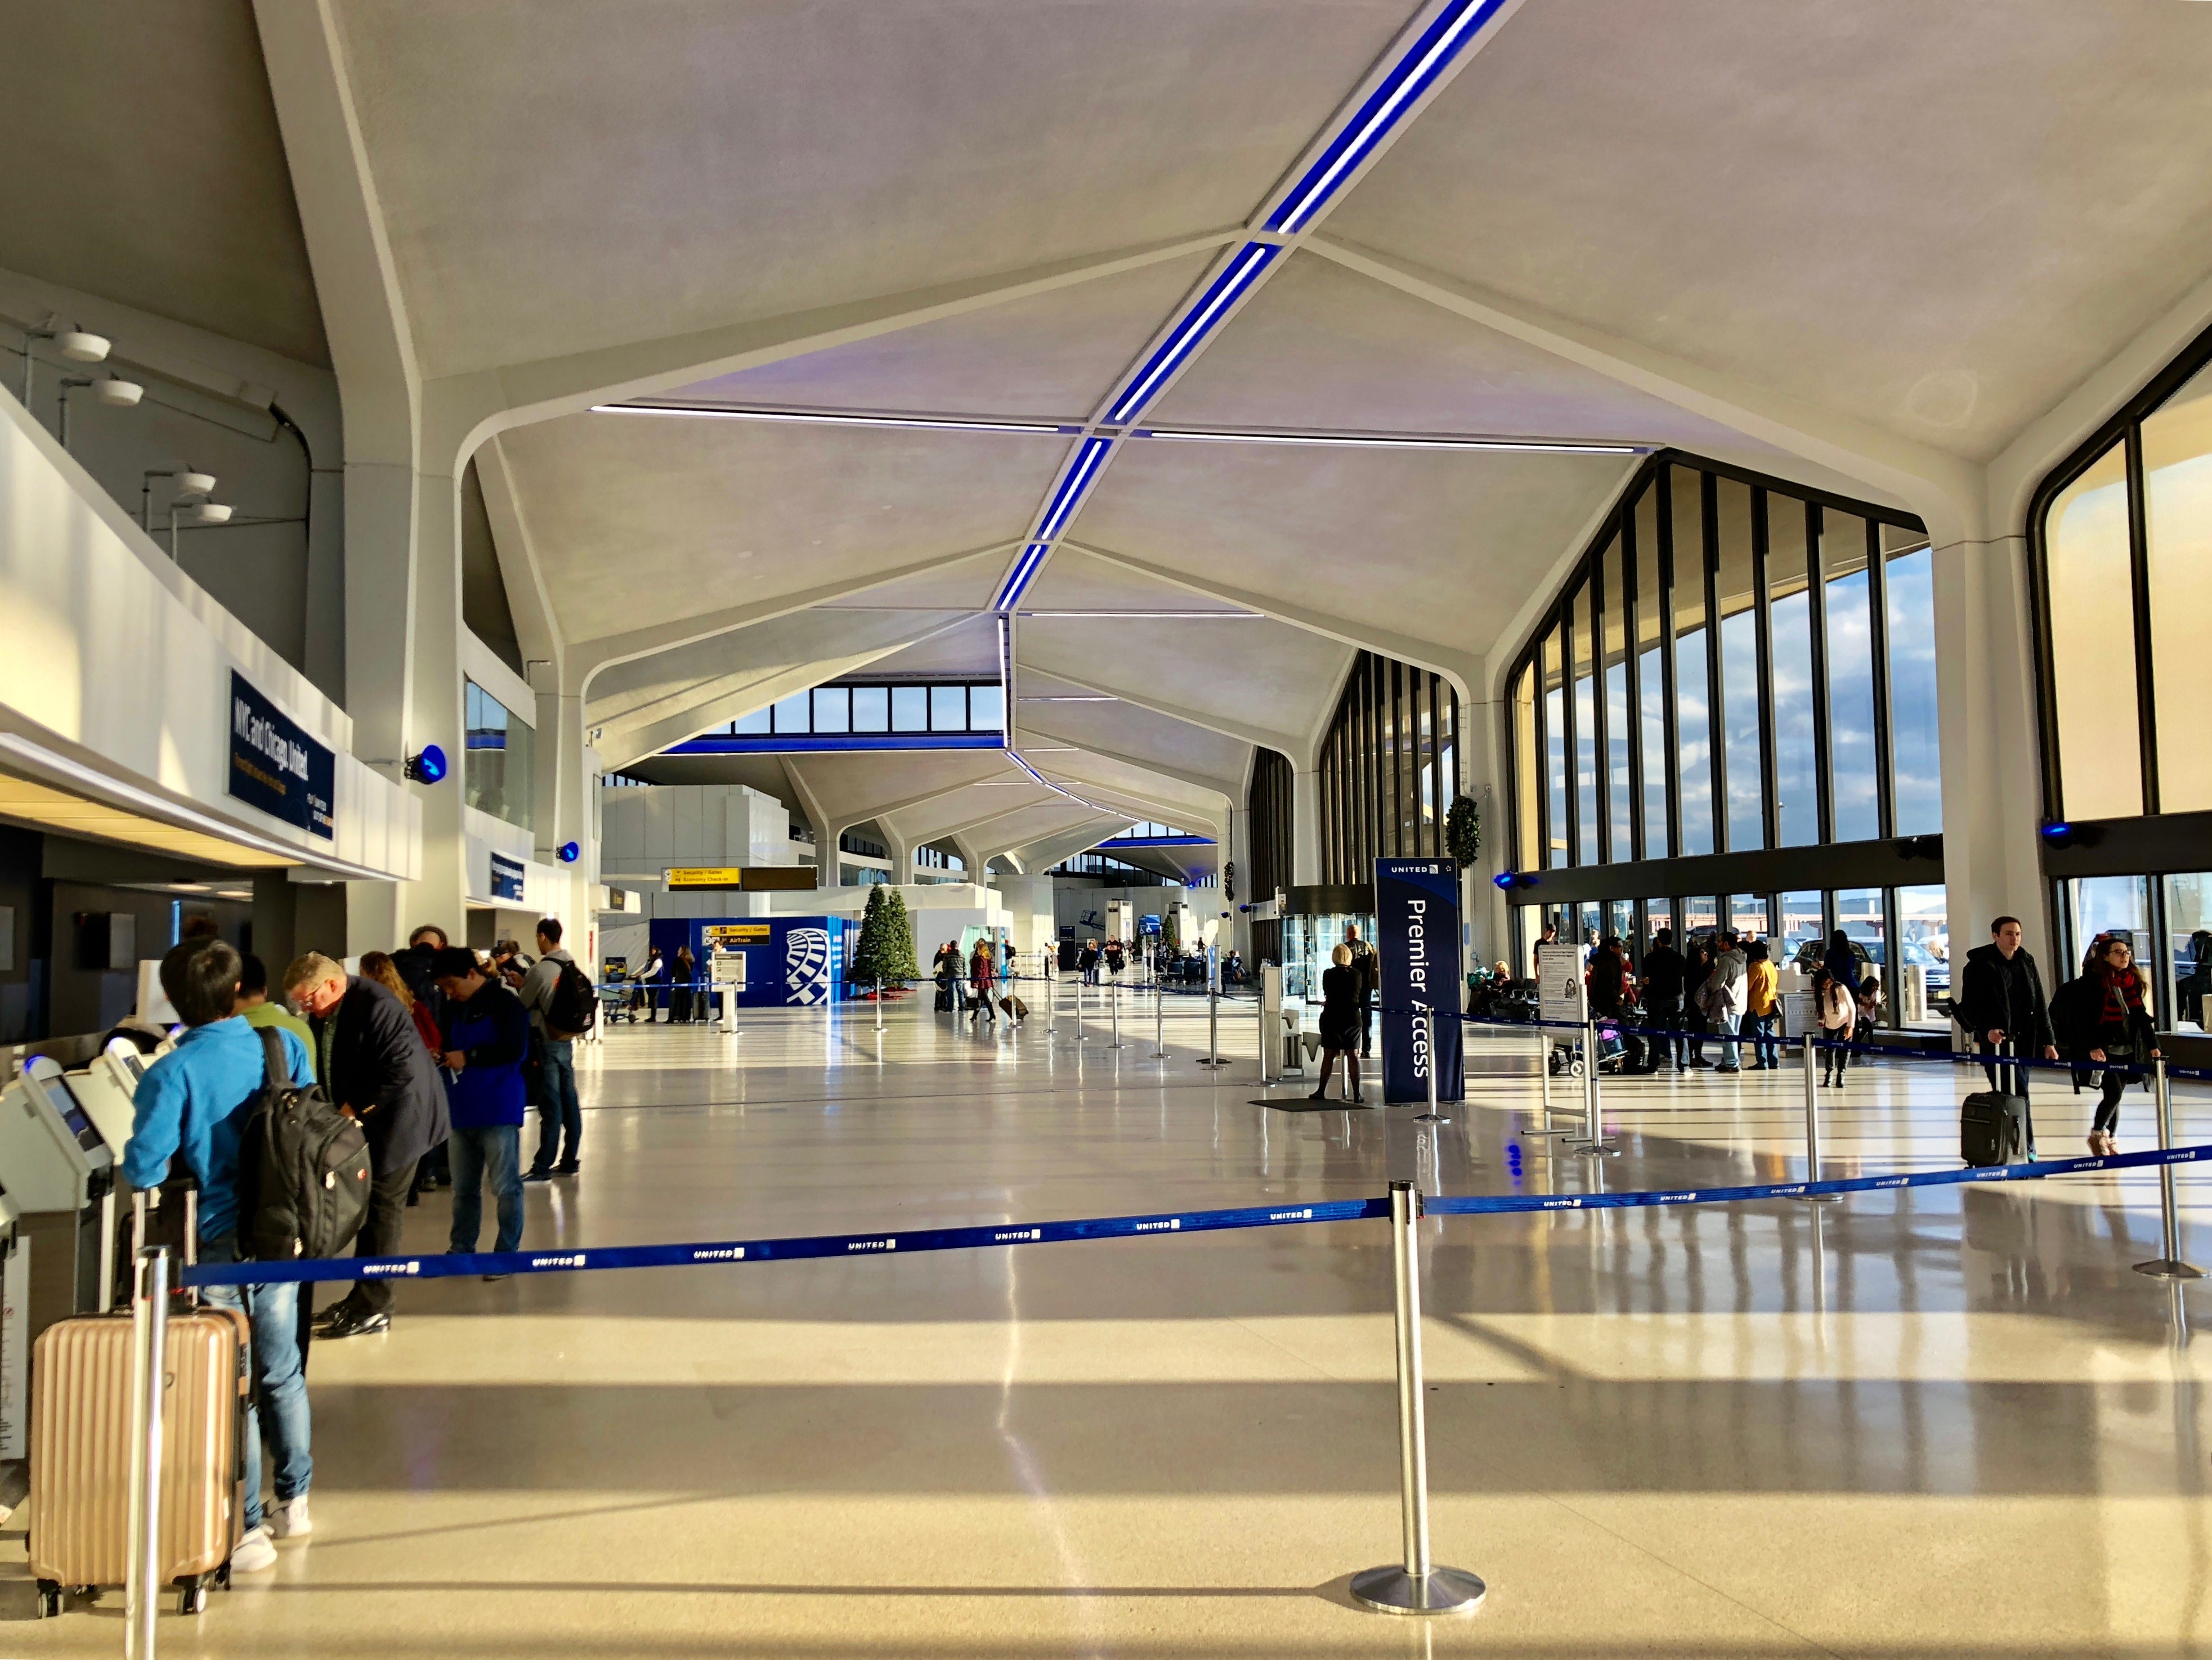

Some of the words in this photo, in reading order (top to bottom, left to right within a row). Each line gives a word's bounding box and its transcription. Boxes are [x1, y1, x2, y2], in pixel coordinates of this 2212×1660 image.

[1408, 900, 1430, 993] Premier
[1411, 999, 1429, 1078] Access
[1270, 1211, 1303, 1220] UNITED
[1136, 1221, 1170, 1230] UNITED
[995, 1231, 1031, 1240] UNITED
[848, 1241, 885, 1250] UNITED
[694, 1250, 733, 1259] UNITED
[532, 1257, 574, 1267] UNITED
[364, 1264, 406, 1274] UNITED
